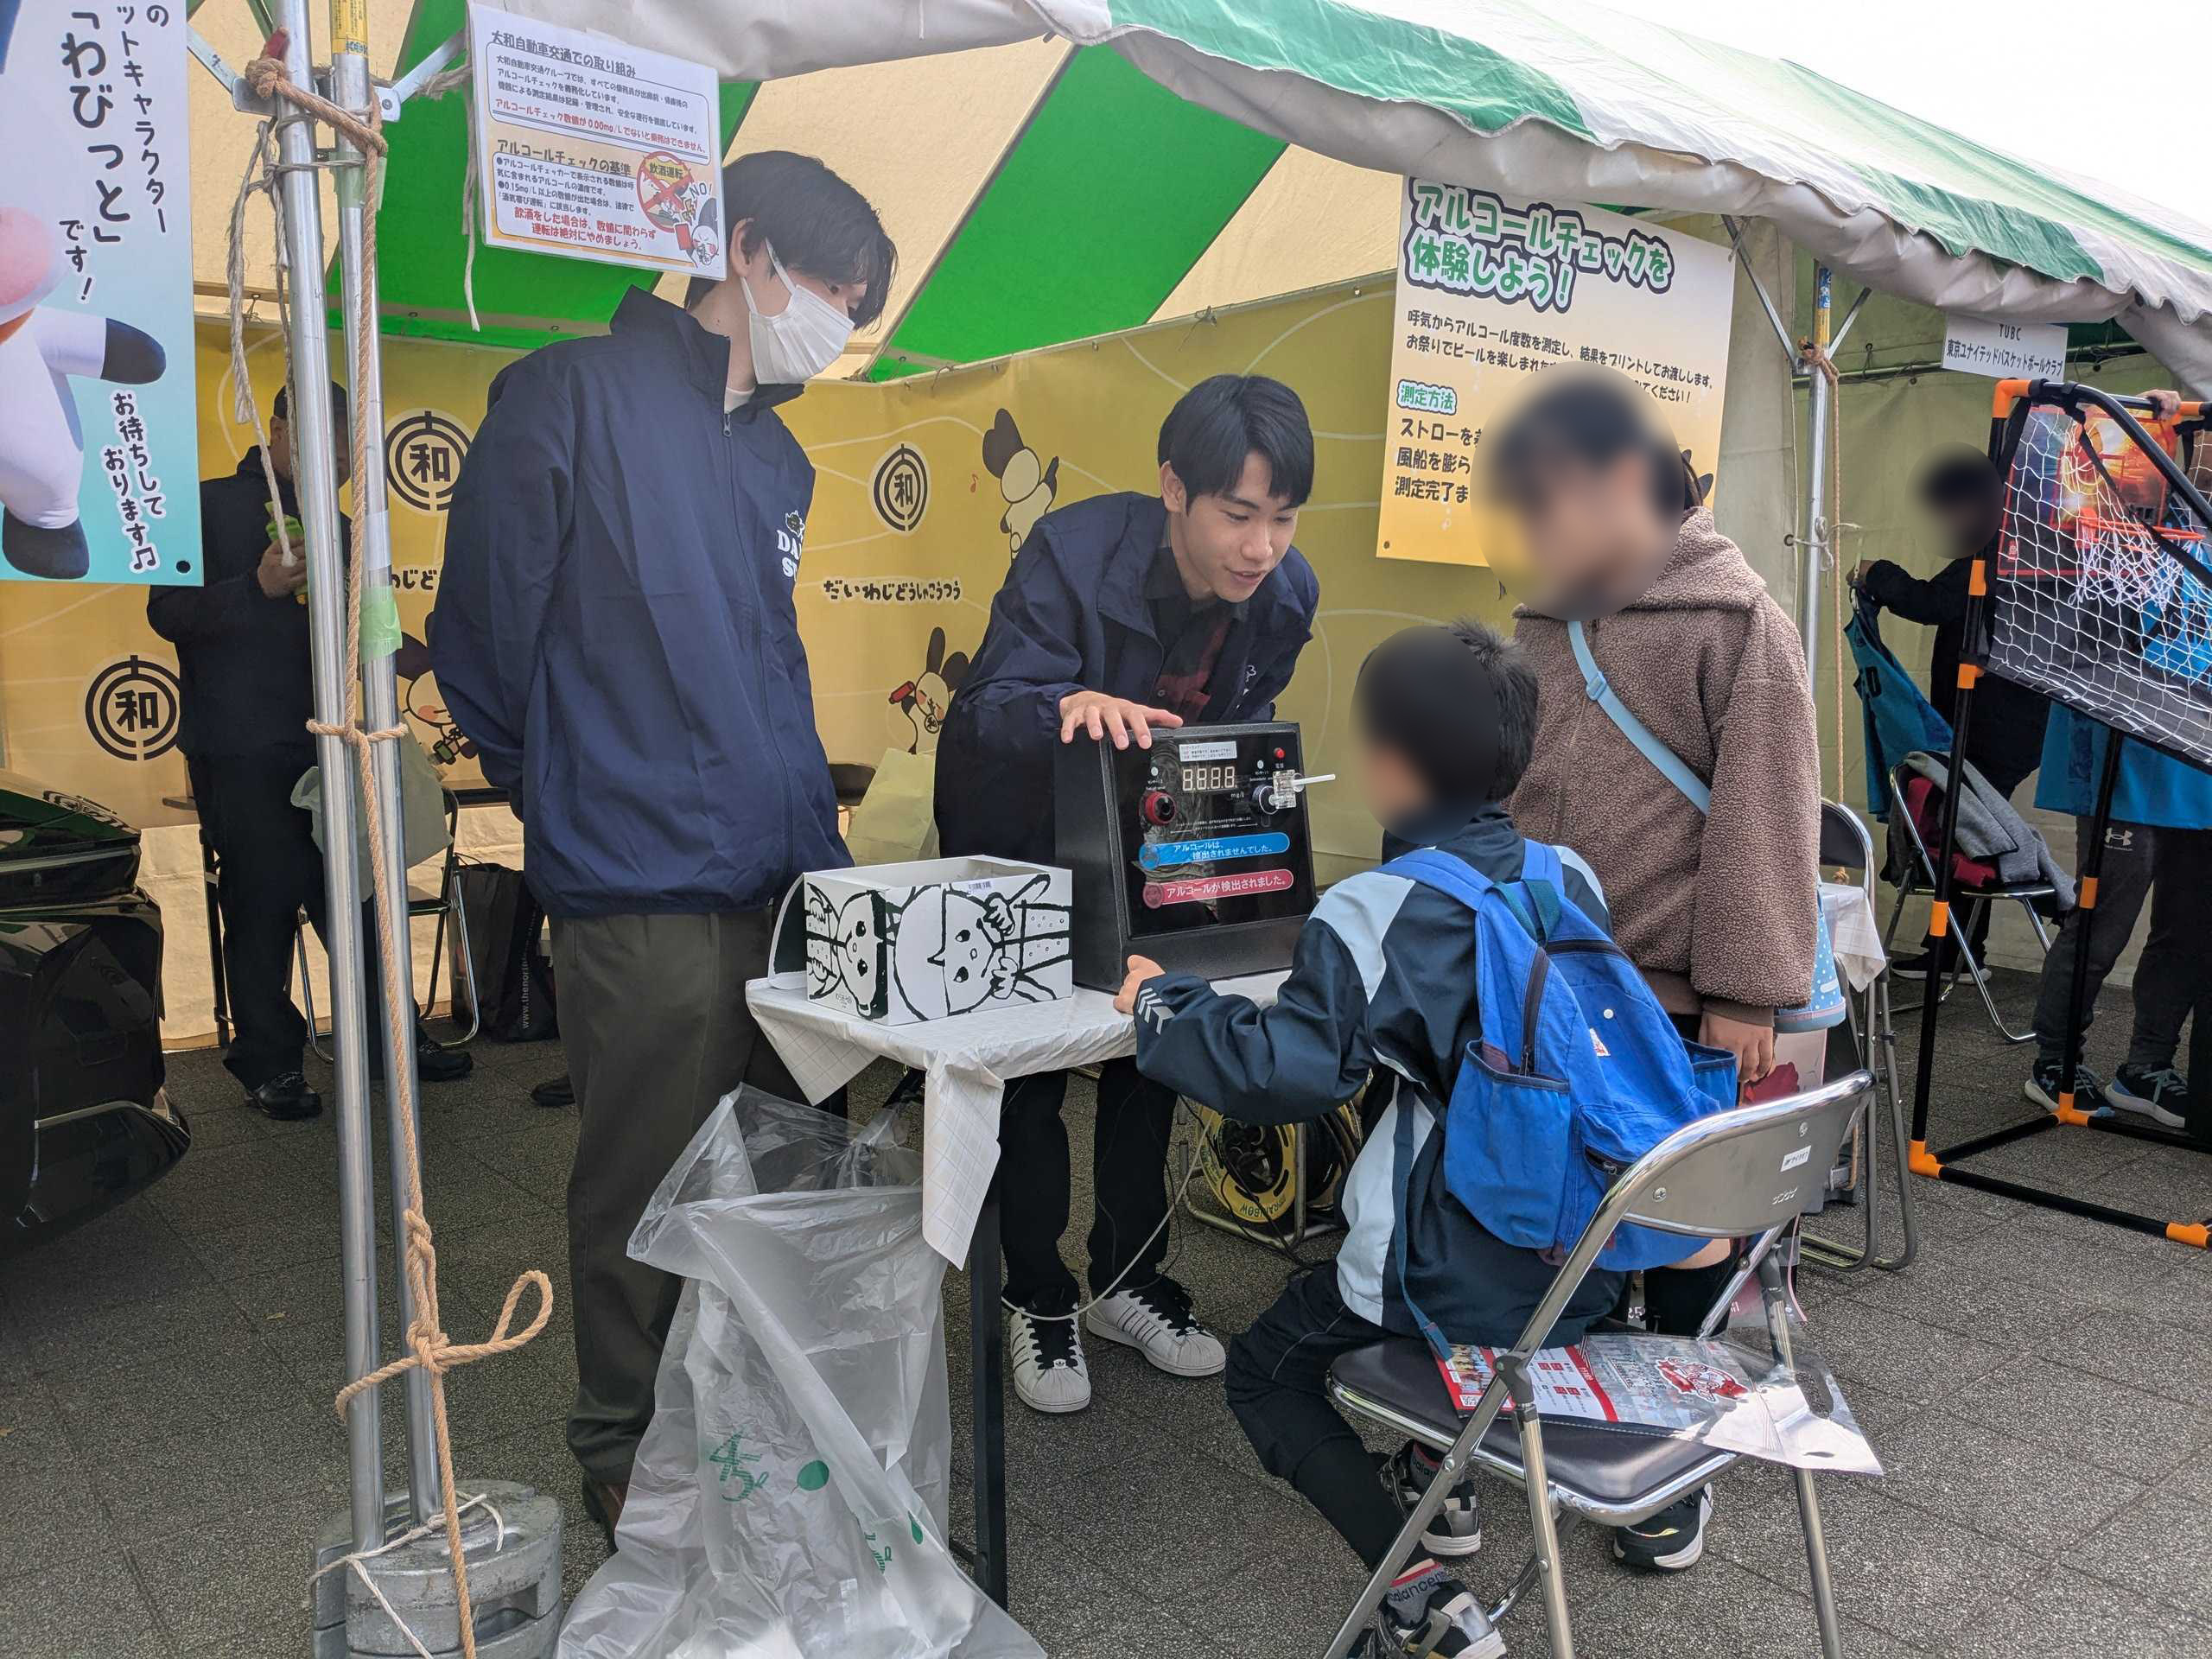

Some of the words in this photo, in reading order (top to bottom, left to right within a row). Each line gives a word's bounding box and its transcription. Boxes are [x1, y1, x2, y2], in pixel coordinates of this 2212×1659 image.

[146, 5, 169, 27] の
[492, 30, 636, 77] 大和自動車交通での取り組み
[117, 6, 167, 233] ットキャラクター
[498, 139, 631, 176] アルコールチェックの基準
[1413, 180, 1673, 290] アルコールチェックを
[1408, 229, 1577, 309] 体験しよう!
[1999, 323, 2022, 340] TUBC
[1406, 334, 1556, 372] お祭りでビールを楽しまれた
[1946, 338, 2063, 376] 東京ユナイテッドバスケットボールクラブ
[1401, 385, 1453, 410] 測定方法
[113, 391, 162, 516] お待ちして
[409, 442, 452, 484] 和
[893, 473, 914, 508] 和
[1395, 476, 1469, 503] 測定完了ま
[114, 689, 159, 733] 和
